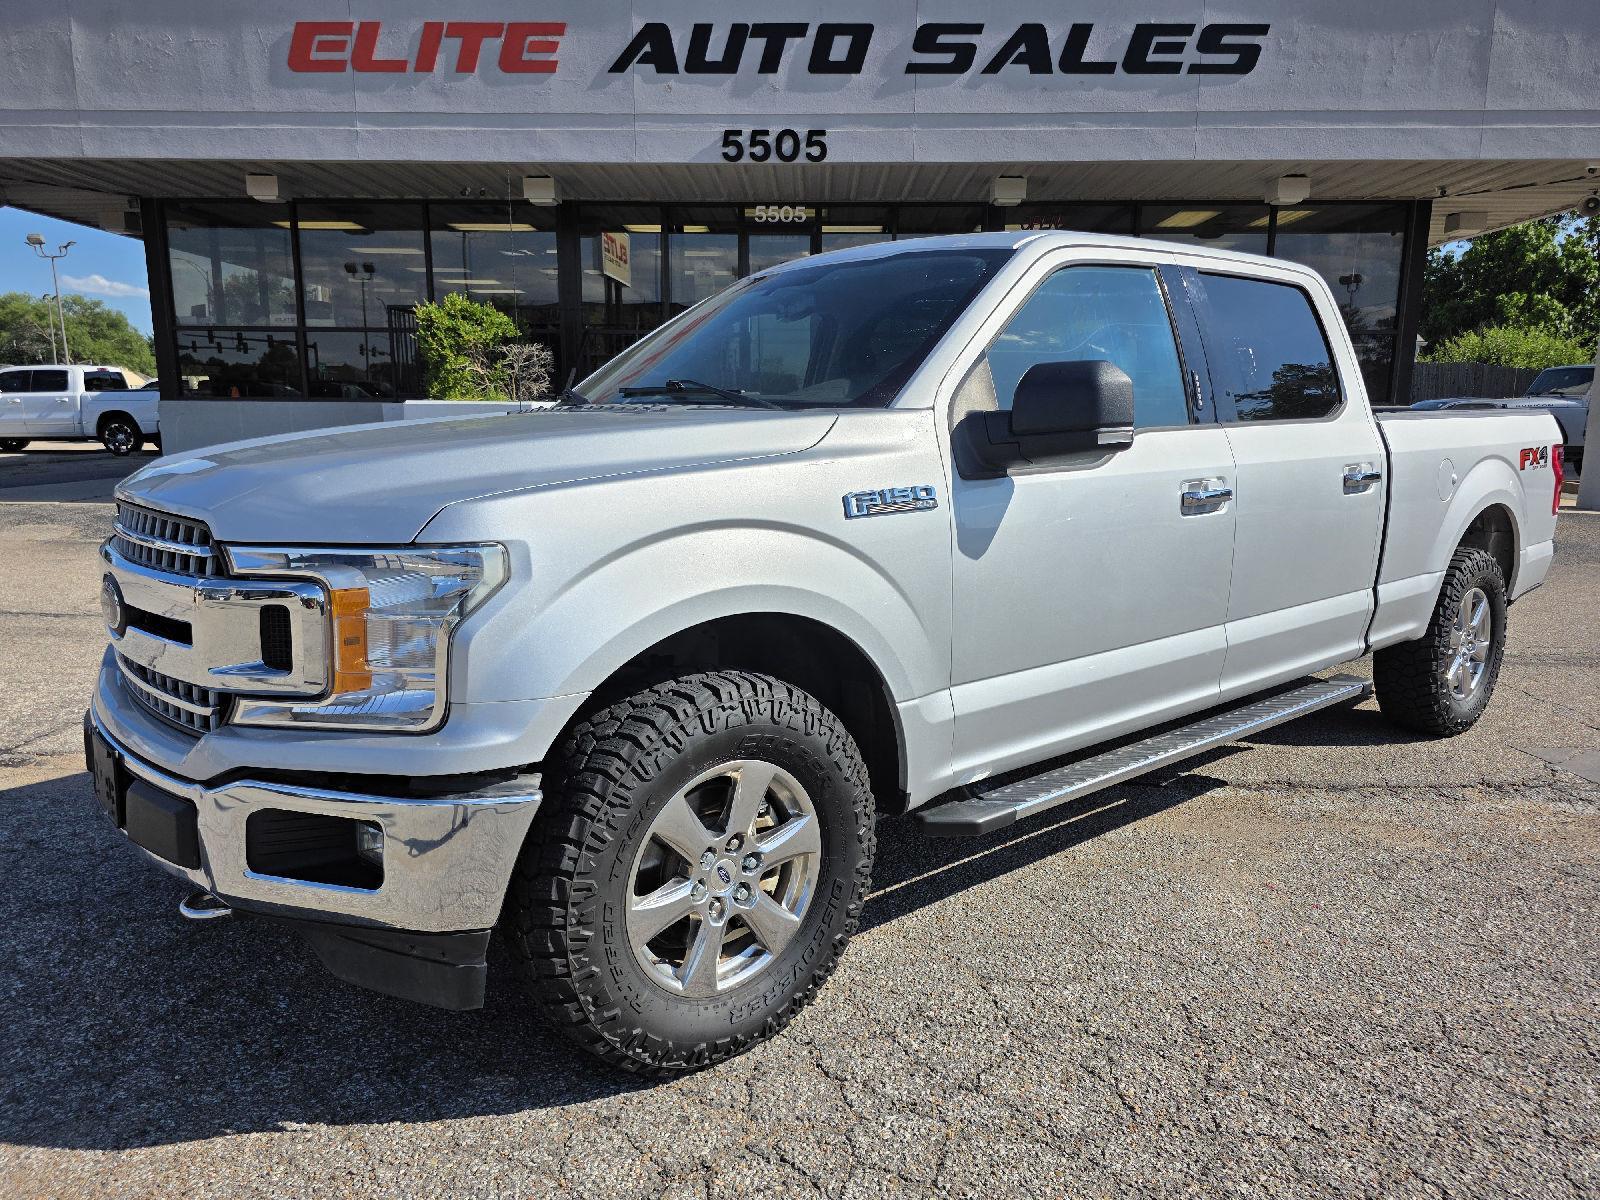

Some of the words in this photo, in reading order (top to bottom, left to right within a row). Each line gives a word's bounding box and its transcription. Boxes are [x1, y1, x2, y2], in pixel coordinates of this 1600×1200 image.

[287, 22, 567, 73] ELITE
[609, 23, 875, 75] AUTO
[905, 23, 1271, 75] SALES
[722, 129, 828, 163] 5505
[754, 205, 807, 223] 5505
[1519, 445, 1548, 471] FX4
[608, 793, 656, 882] TREK
[729, 878, 846, 1024] DISCOVERER
